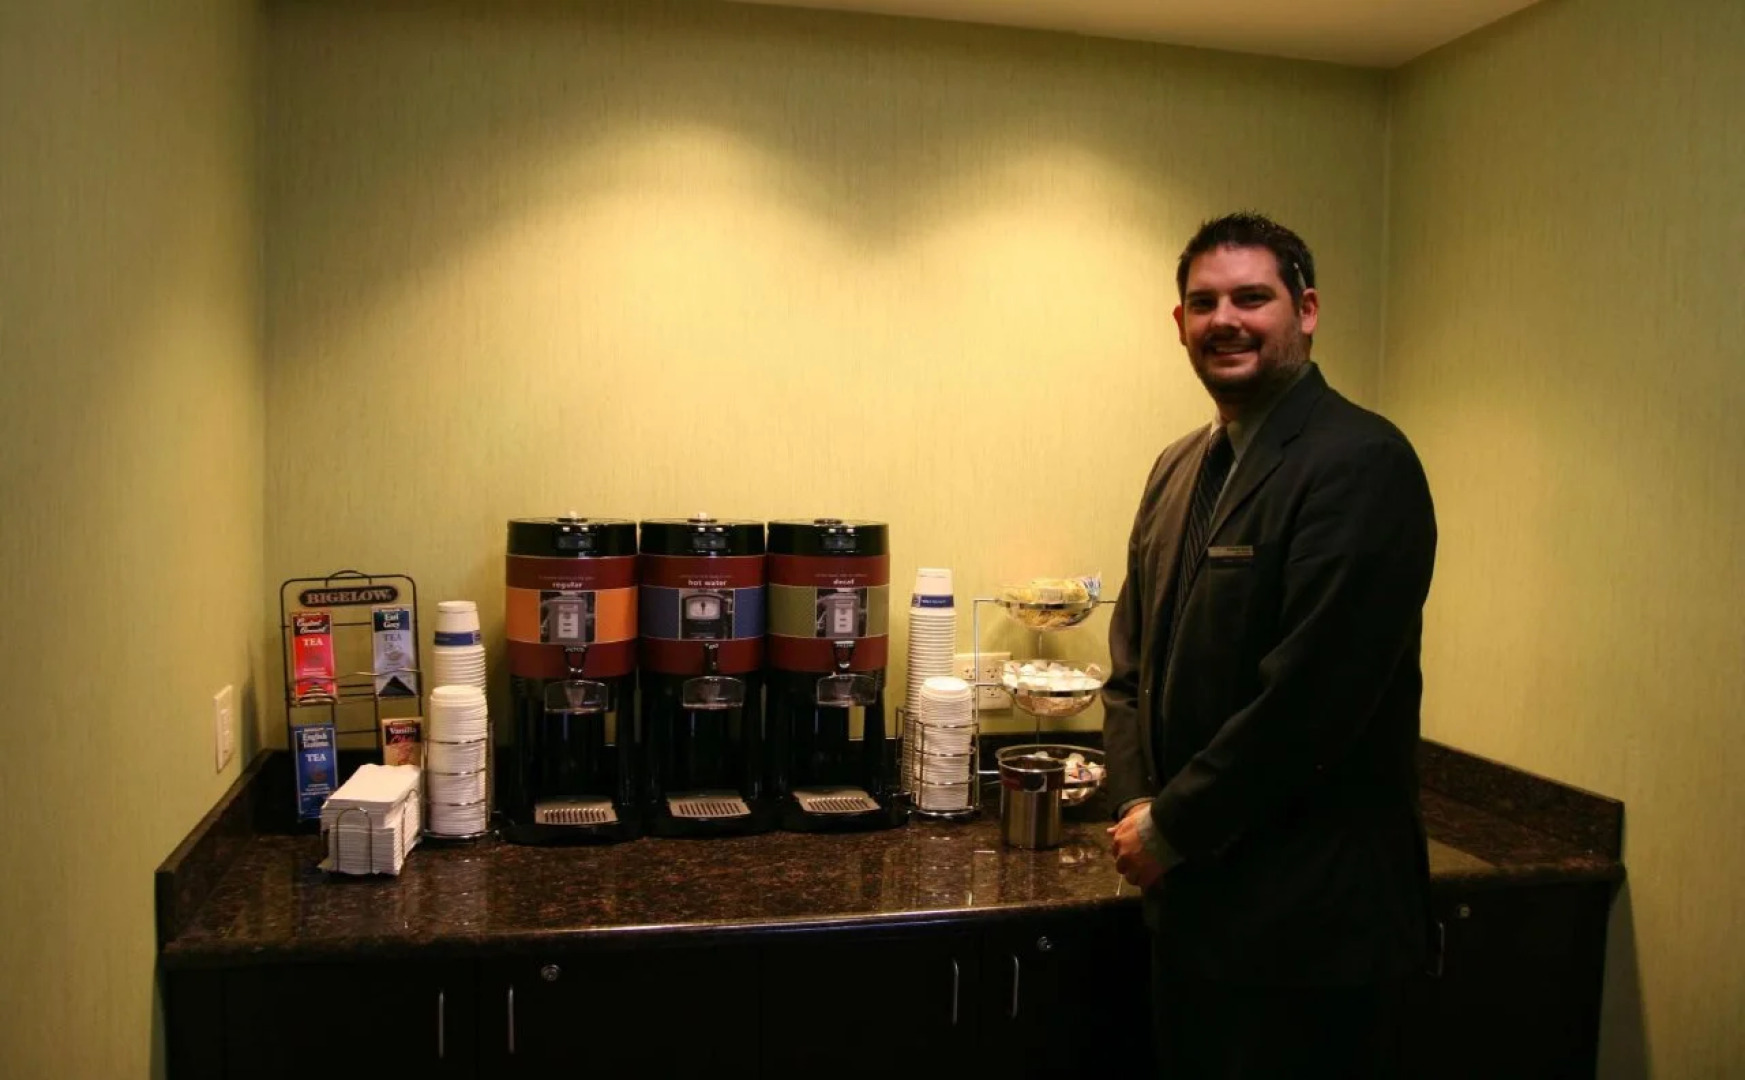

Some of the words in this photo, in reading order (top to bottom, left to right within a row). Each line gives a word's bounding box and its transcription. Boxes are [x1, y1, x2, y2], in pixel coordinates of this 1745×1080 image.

[551, 581, 583, 590] regular
[306, 589, 390, 604] BIGELOW
[383, 611, 399, 621] Earl
[302, 637, 324, 646] TEA
[383, 633, 402, 642] TEA
[304, 753, 327, 762] TEA
